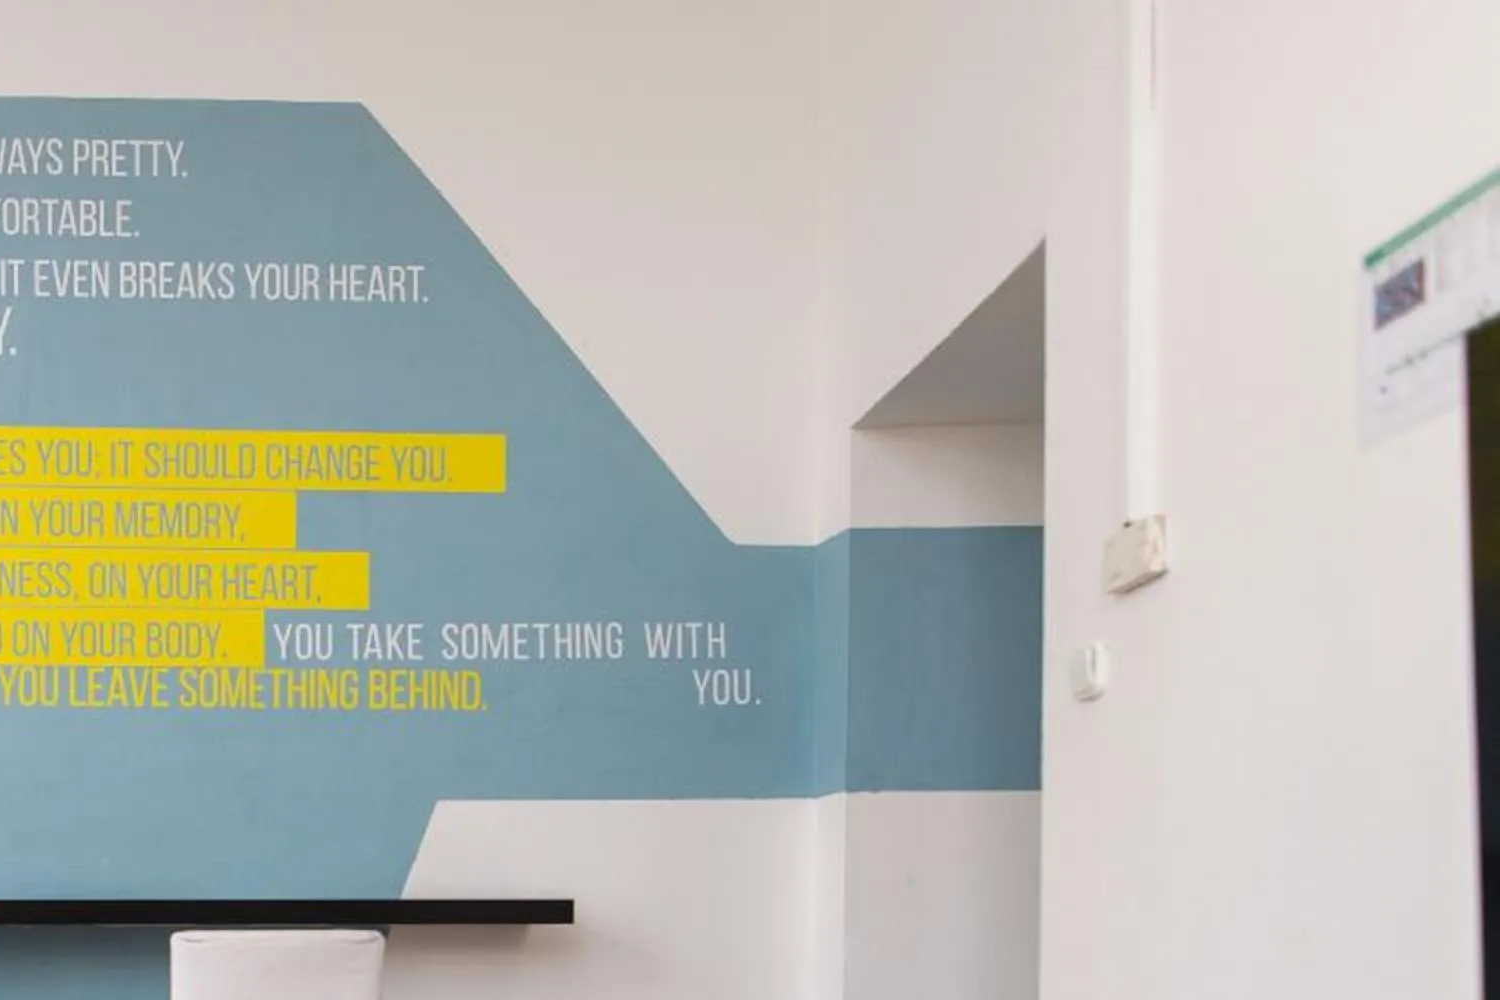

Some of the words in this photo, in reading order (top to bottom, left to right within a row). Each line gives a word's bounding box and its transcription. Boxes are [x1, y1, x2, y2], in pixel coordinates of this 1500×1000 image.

[72, 139, 189, 178] PRETTY.
[0, 259, 25, 298] IT
[33, 260, 111, 299] EVEN
[119, 261, 236, 300] BREAKS
[244, 263, 321, 301] YOUR
[329, 264, 429, 304] HEART.
[110, 440, 135, 479] IT
[143, 441, 257, 480] SHOULD
[265, 443, 381, 483] CHANGE
[390, 445, 453, 484] YOU.
[26, 500, 106, 539] YOUR
[115, 501, 246, 543] MEMORY,
[89, 561, 128, 599] ON
[136, 562, 214, 600] YOUR
[222, 563, 322, 604] HEART,
[11, 620, 50, 657] ON
[59, 621, 136, 659] YOUR
[146, 622, 228, 659] BODY.
[273, 623, 333, 660] YOU
[346, 623, 424, 661] TAKE
[441, 622, 624, 661] SOMETHING
[644, 621, 726, 660] WITH
[0, 664, 62, 708] YOU
[68, 665, 169, 708] LEAVE
[178, 666, 358, 710] SOMETHING
[367, 668, 487, 711] BEHIND.
[692, 668, 762, 706] YOU.
